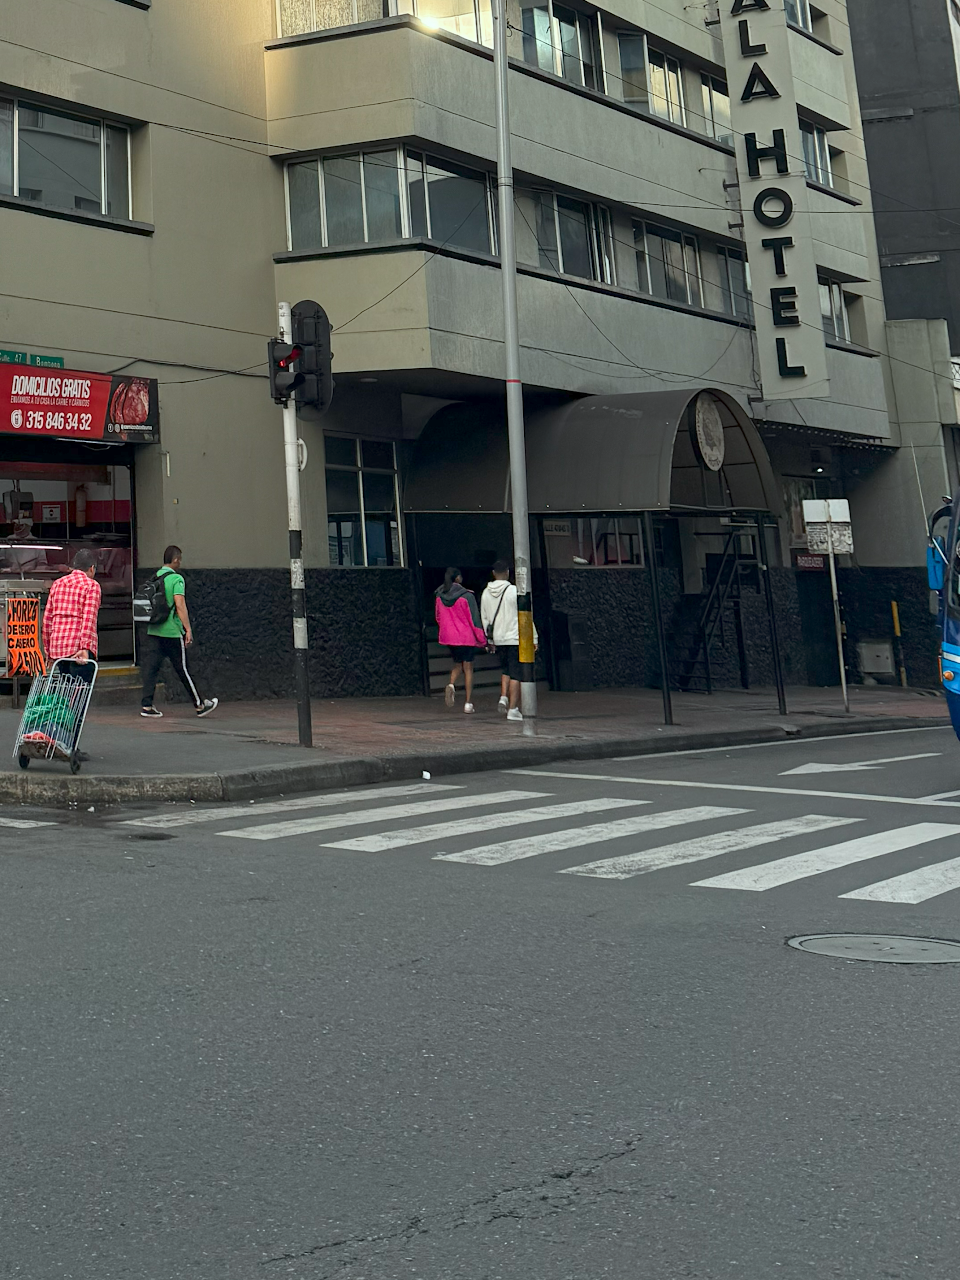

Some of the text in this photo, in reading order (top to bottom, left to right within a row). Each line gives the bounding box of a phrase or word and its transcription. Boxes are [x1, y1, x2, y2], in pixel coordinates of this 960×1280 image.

[744, 128, 807, 378] HOTEL
[14, 353, 22, 363] 47
[11, 375, 91, 398] DOMICILIOS GRATIS
[26, 410, 92, 431] 315 846 34 32
